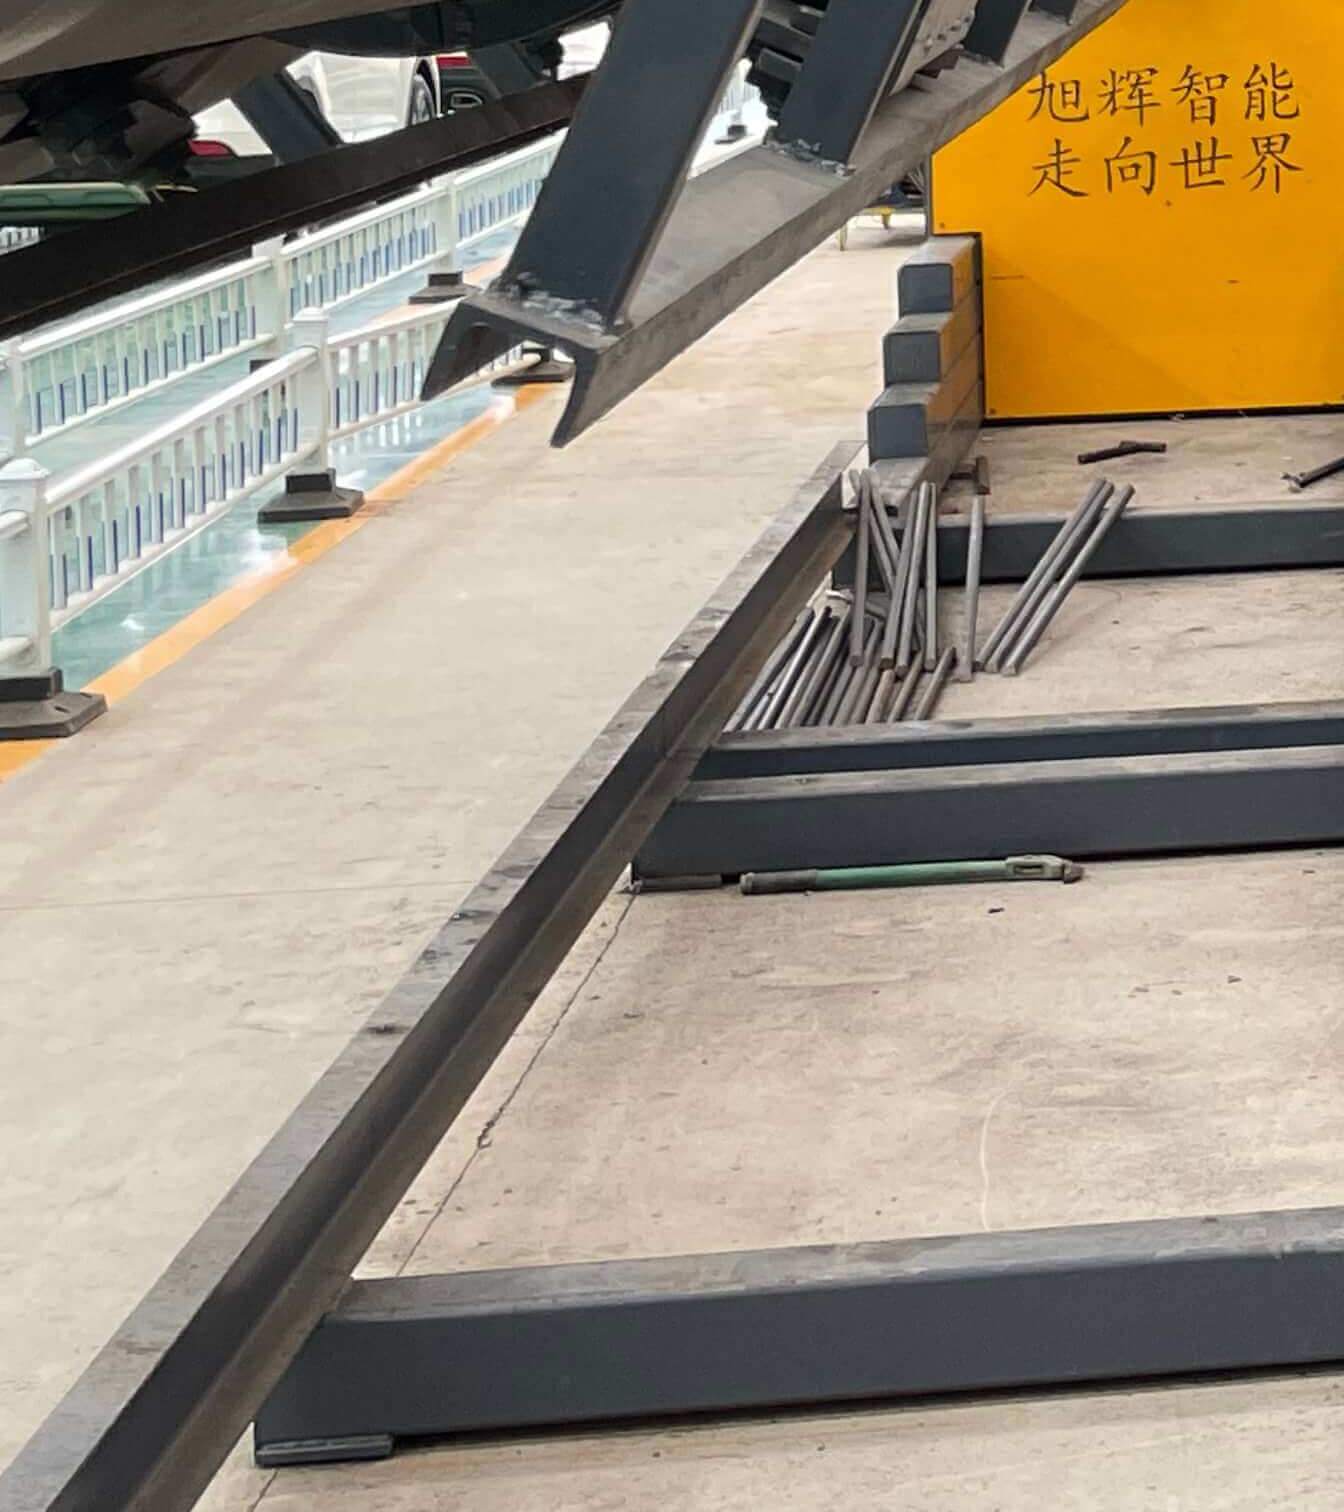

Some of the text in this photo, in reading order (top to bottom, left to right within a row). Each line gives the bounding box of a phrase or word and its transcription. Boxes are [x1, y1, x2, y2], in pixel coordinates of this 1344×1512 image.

[1027, 62, 1301, 127] 旭辉智能
[1026, 133, 1304, 198] 走向世界
